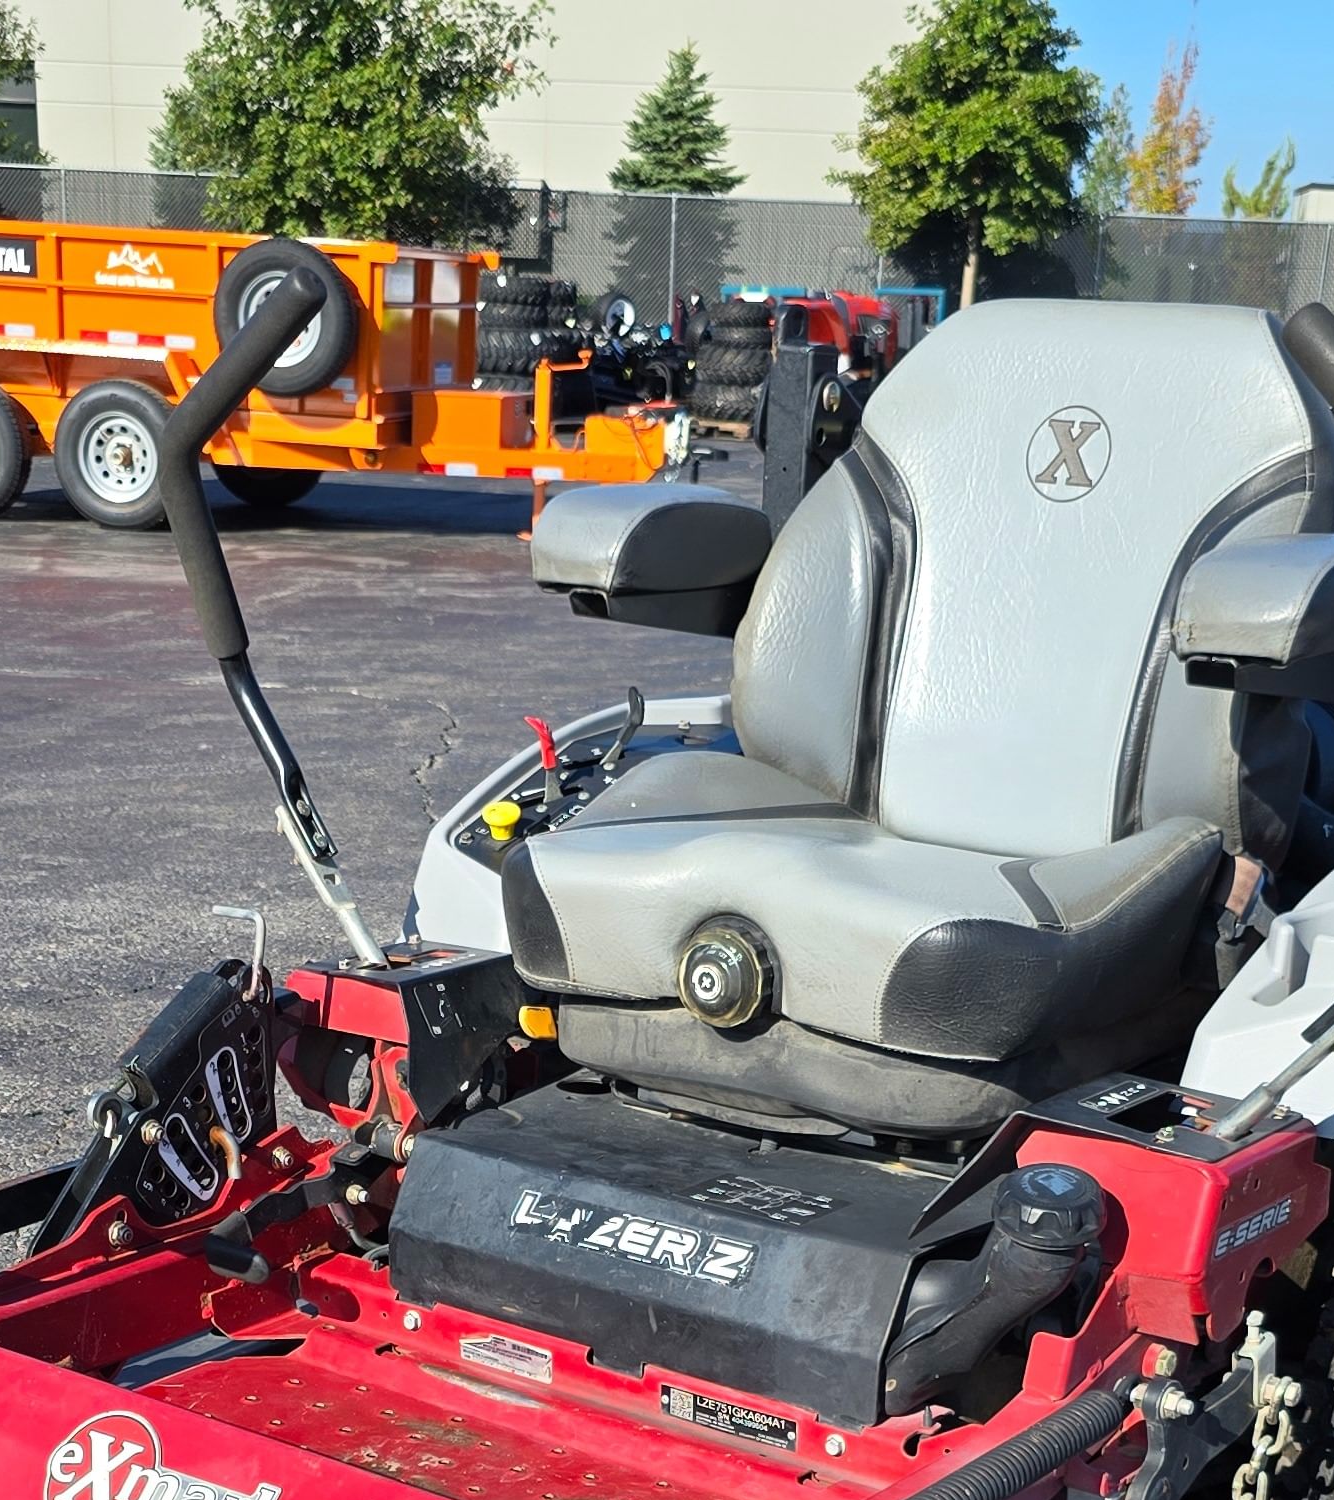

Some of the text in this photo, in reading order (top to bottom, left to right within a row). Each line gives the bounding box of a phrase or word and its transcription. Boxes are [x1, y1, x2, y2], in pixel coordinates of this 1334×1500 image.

[1034, 418, 1102, 488] X
[510, 1190, 701, 1275] LZER
[695, 1236, 755, 1286] Z
[1214, 1199, 1292, 1257] E-SERIE
